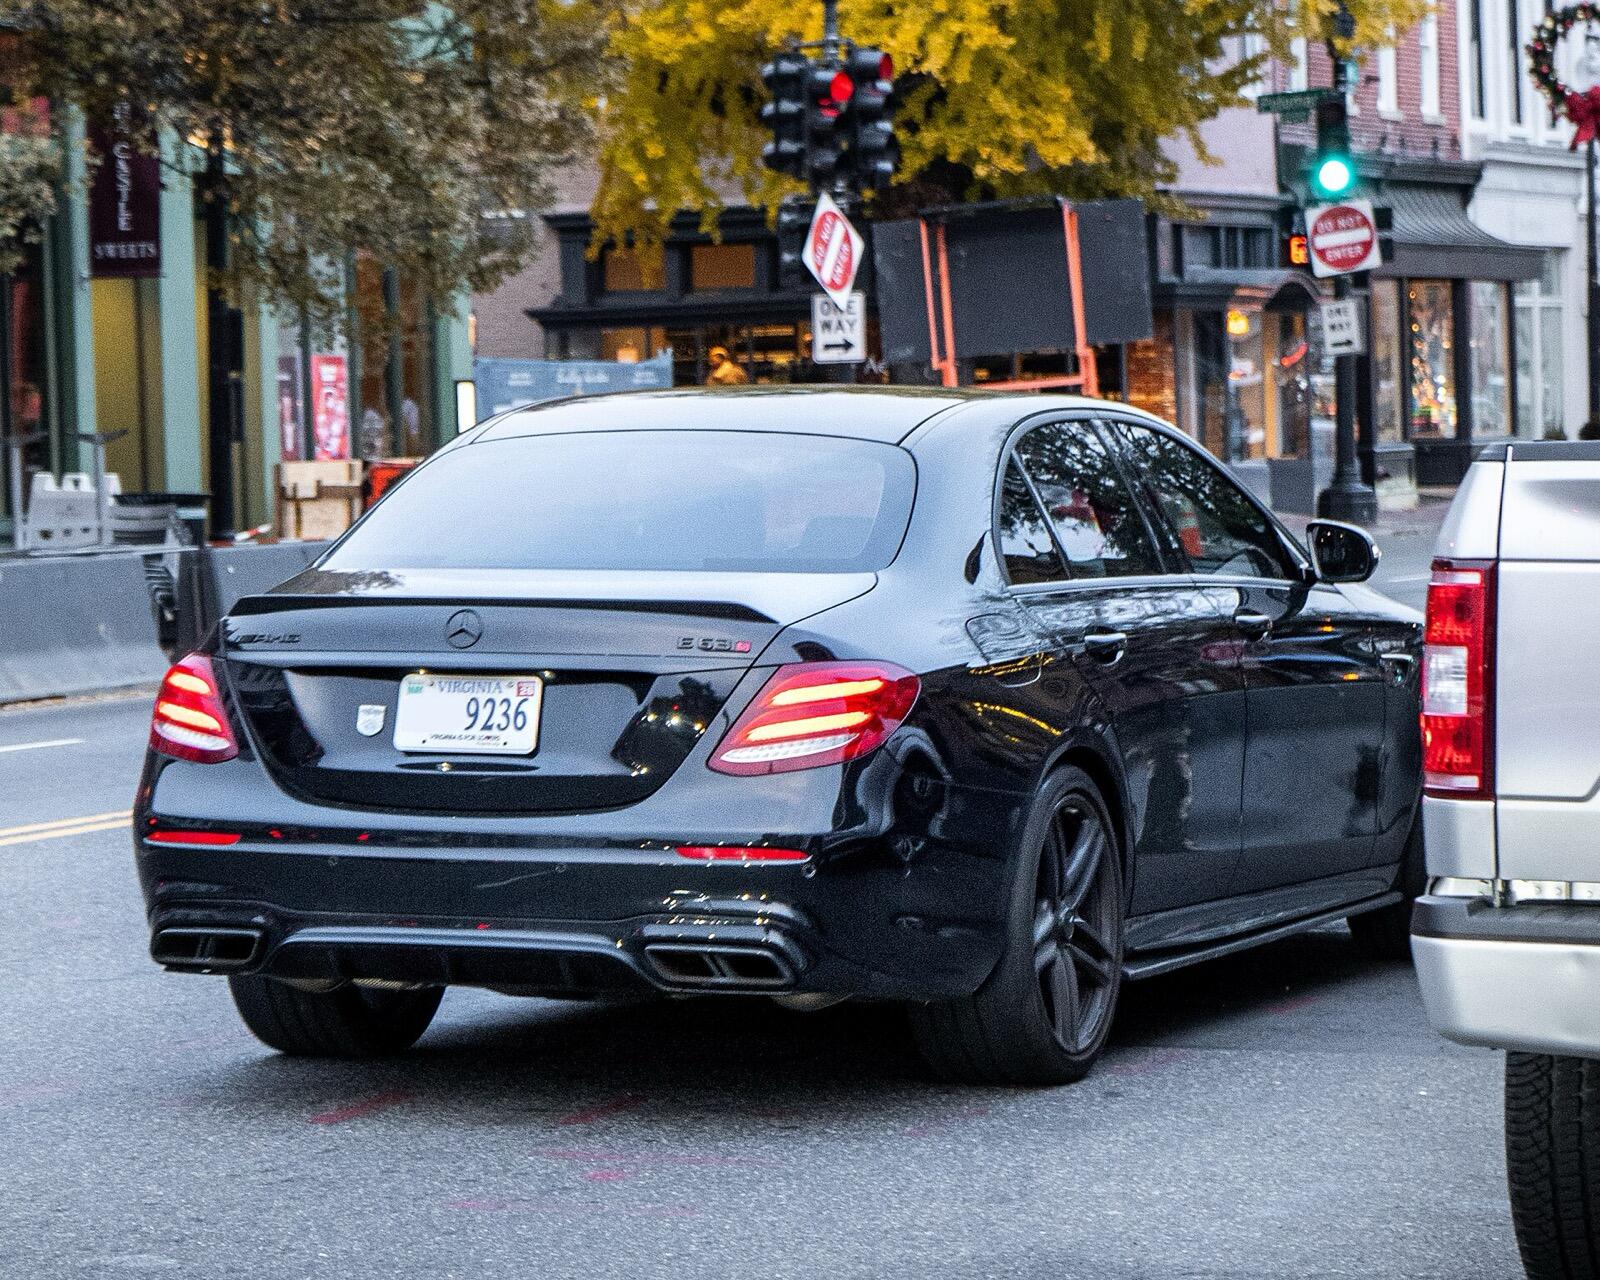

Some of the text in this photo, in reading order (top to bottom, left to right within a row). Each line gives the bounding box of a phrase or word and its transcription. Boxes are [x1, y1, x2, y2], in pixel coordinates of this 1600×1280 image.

[1316, 215, 1363, 235] DO NOT
[1325, 245, 1363, 262] ENTER
[820, 319, 857, 334] WAY
[437, 680, 503, 694] VIRGINIA
[464, 697, 529, 731] 9236
